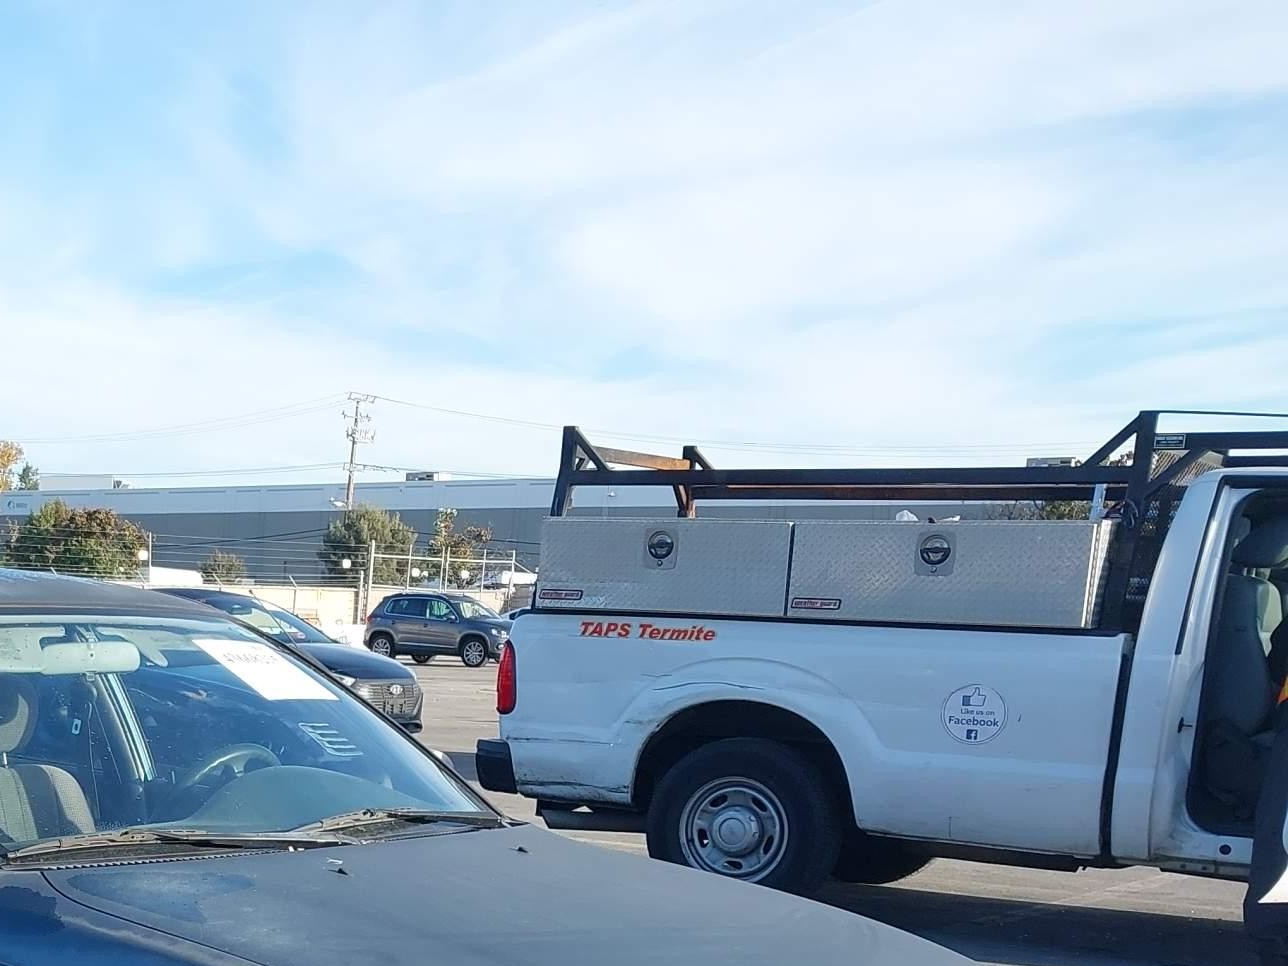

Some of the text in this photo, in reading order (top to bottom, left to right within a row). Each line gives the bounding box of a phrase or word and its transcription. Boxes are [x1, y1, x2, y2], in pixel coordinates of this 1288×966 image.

[580, 621, 716, 640] TAPS Termite
[948, 715, 999, 727] Facebook
